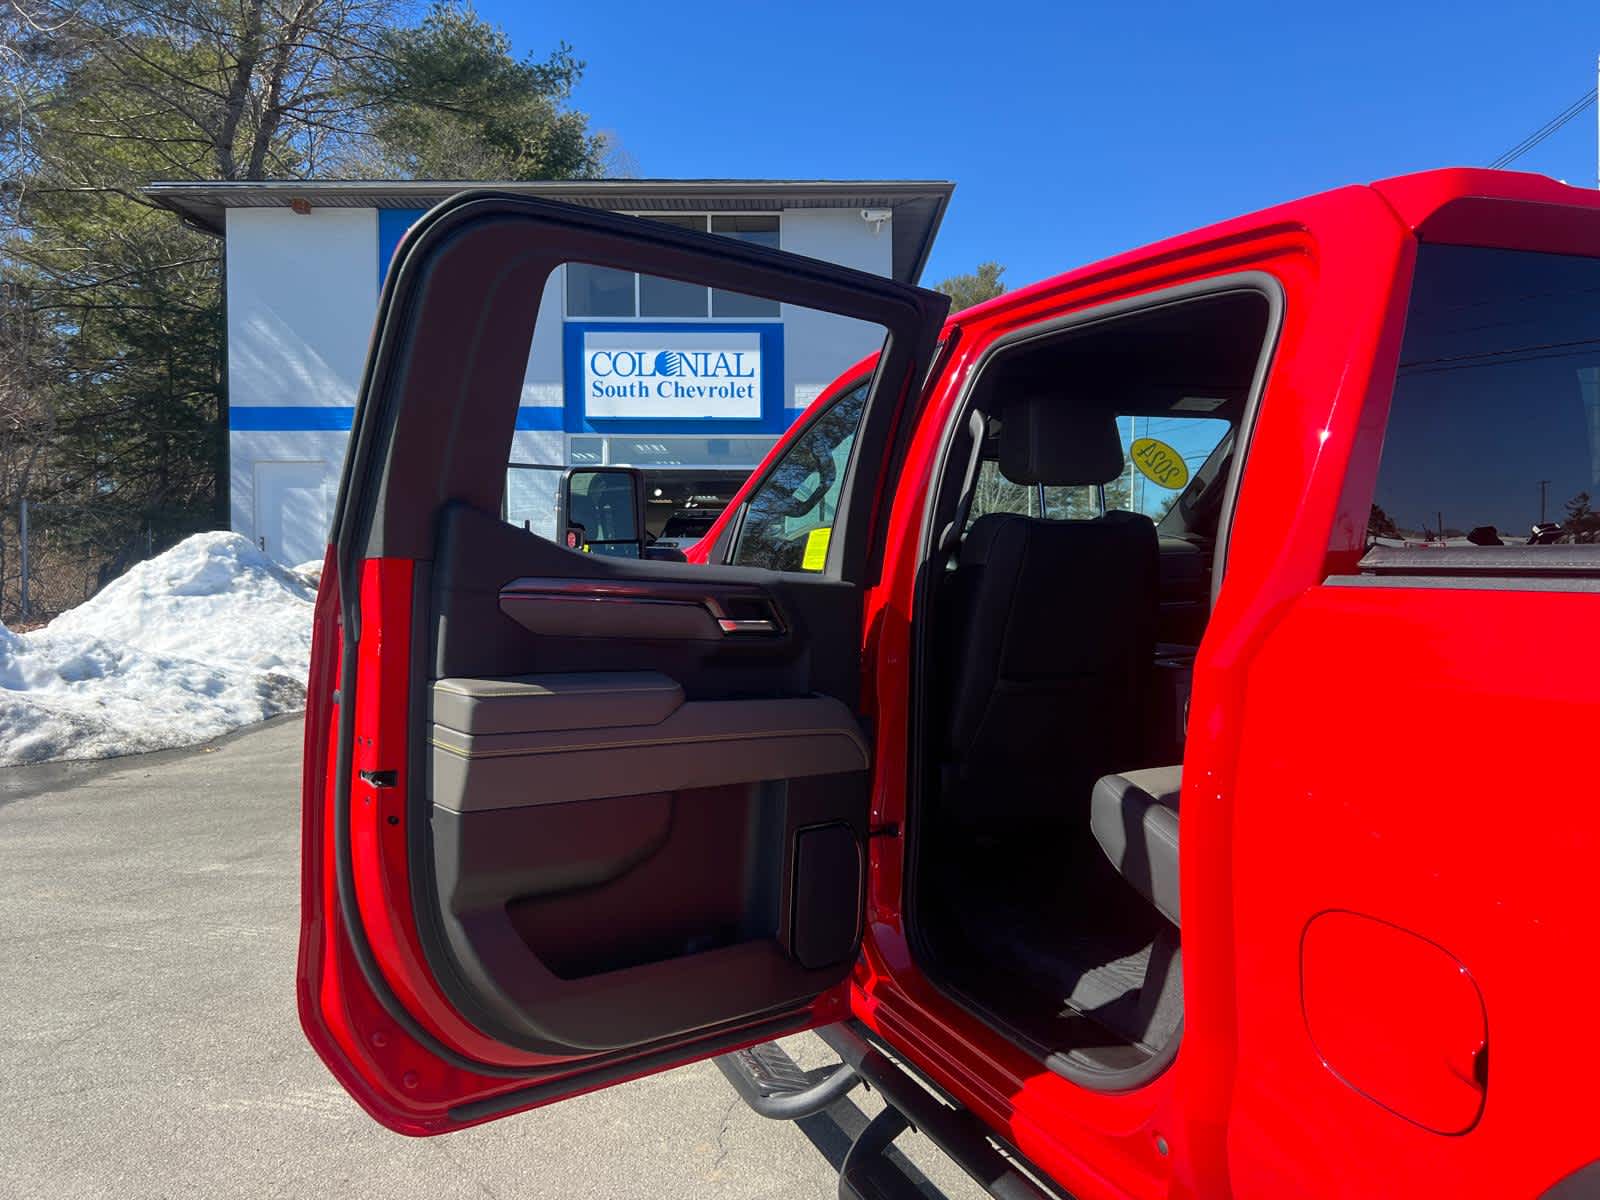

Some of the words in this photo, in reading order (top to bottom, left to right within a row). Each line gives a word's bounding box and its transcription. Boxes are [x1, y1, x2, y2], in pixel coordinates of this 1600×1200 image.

[591, 351, 754, 377] COLONIAL
[592, 381, 649, 398] South
[657, 381, 754, 398] Chevrolet
